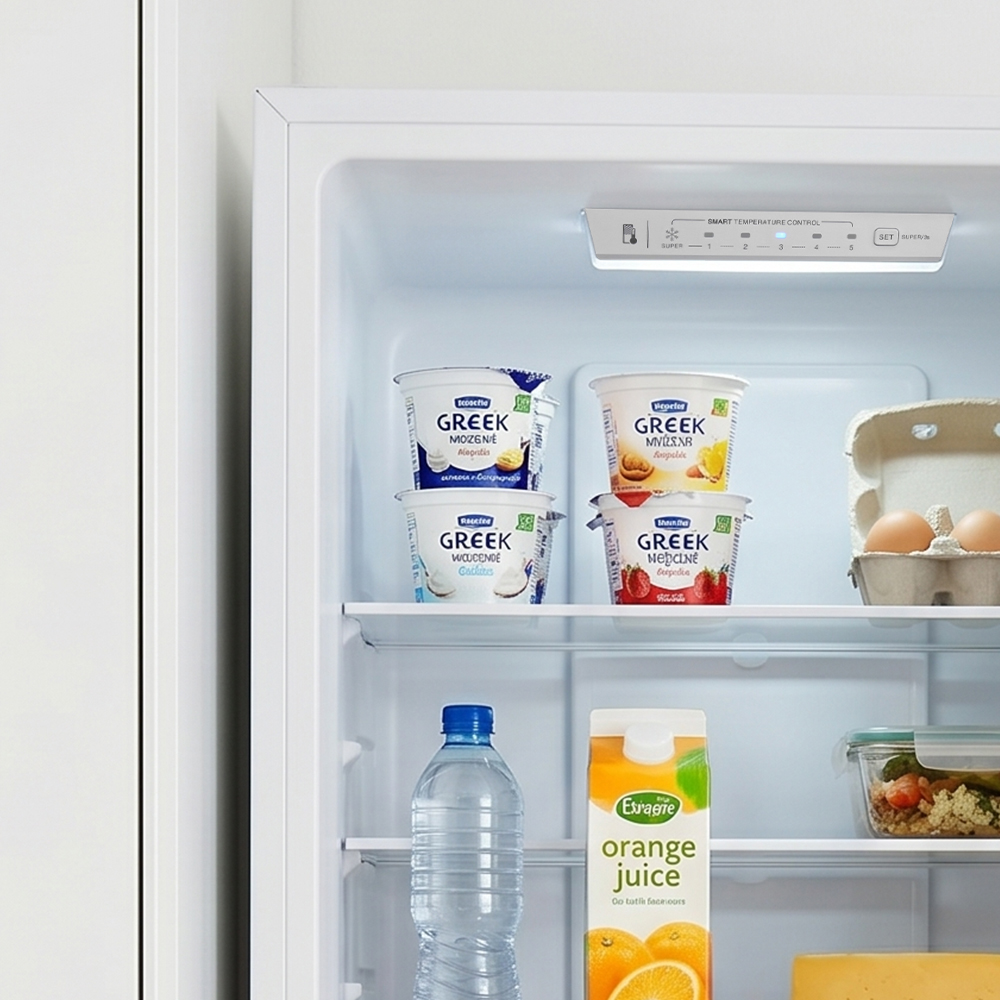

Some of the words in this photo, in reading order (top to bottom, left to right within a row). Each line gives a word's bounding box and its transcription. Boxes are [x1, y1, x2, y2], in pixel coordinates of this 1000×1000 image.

[786, 219, 821, 227] CONTROL
[878, 233, 895, 241] SET
[437, 413, 509, 432] GREEK
[634, 416, 706, 435] GREEK
[440, 531, 512, 550] GREEK
[637, 533, 710, 551] GREEK
[602, 840, 696, 865] orange
[612, 862, 681, 893] juice
